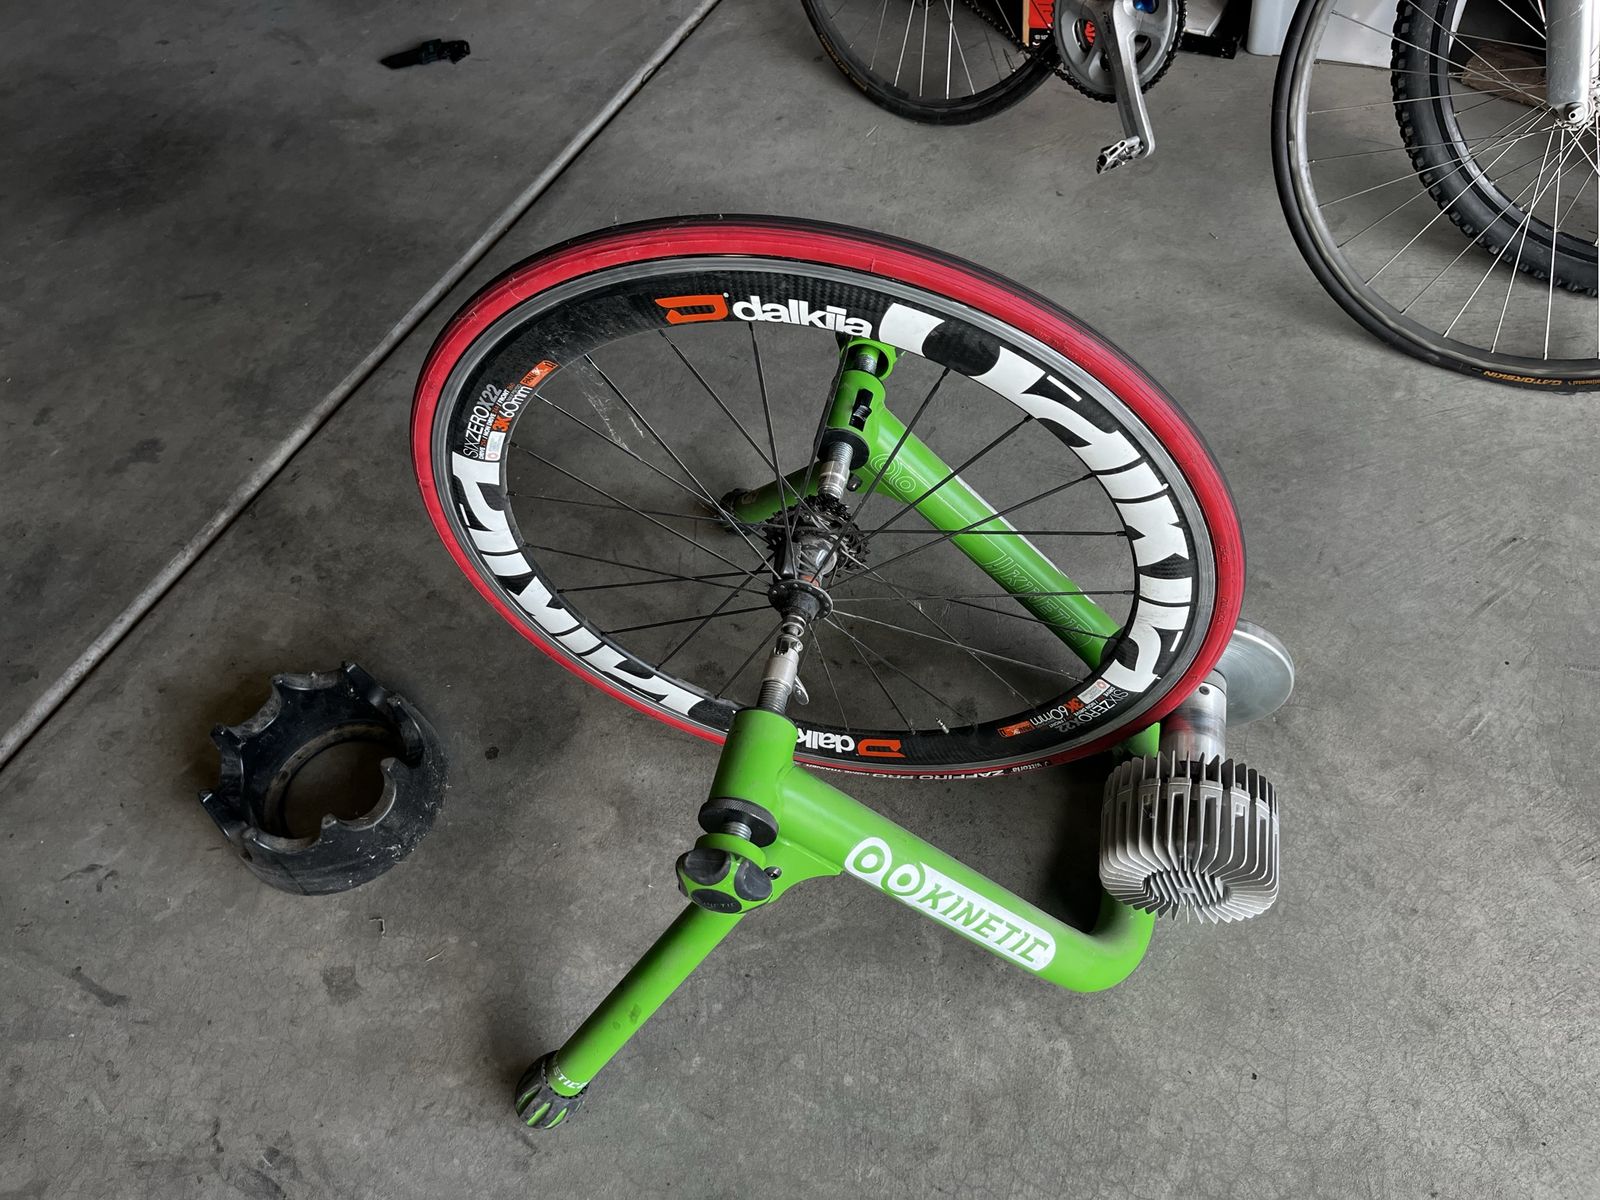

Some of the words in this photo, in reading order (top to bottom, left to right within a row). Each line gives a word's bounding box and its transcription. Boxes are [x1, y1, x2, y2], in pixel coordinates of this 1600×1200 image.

[732, 295, 873, 339] dalkiia
[1483, 370, 1562, 386] GATORSKIN
[919, 769, 1004, 780] ZAFFIRO
[918, 882, 1050, 963] KINETIC
